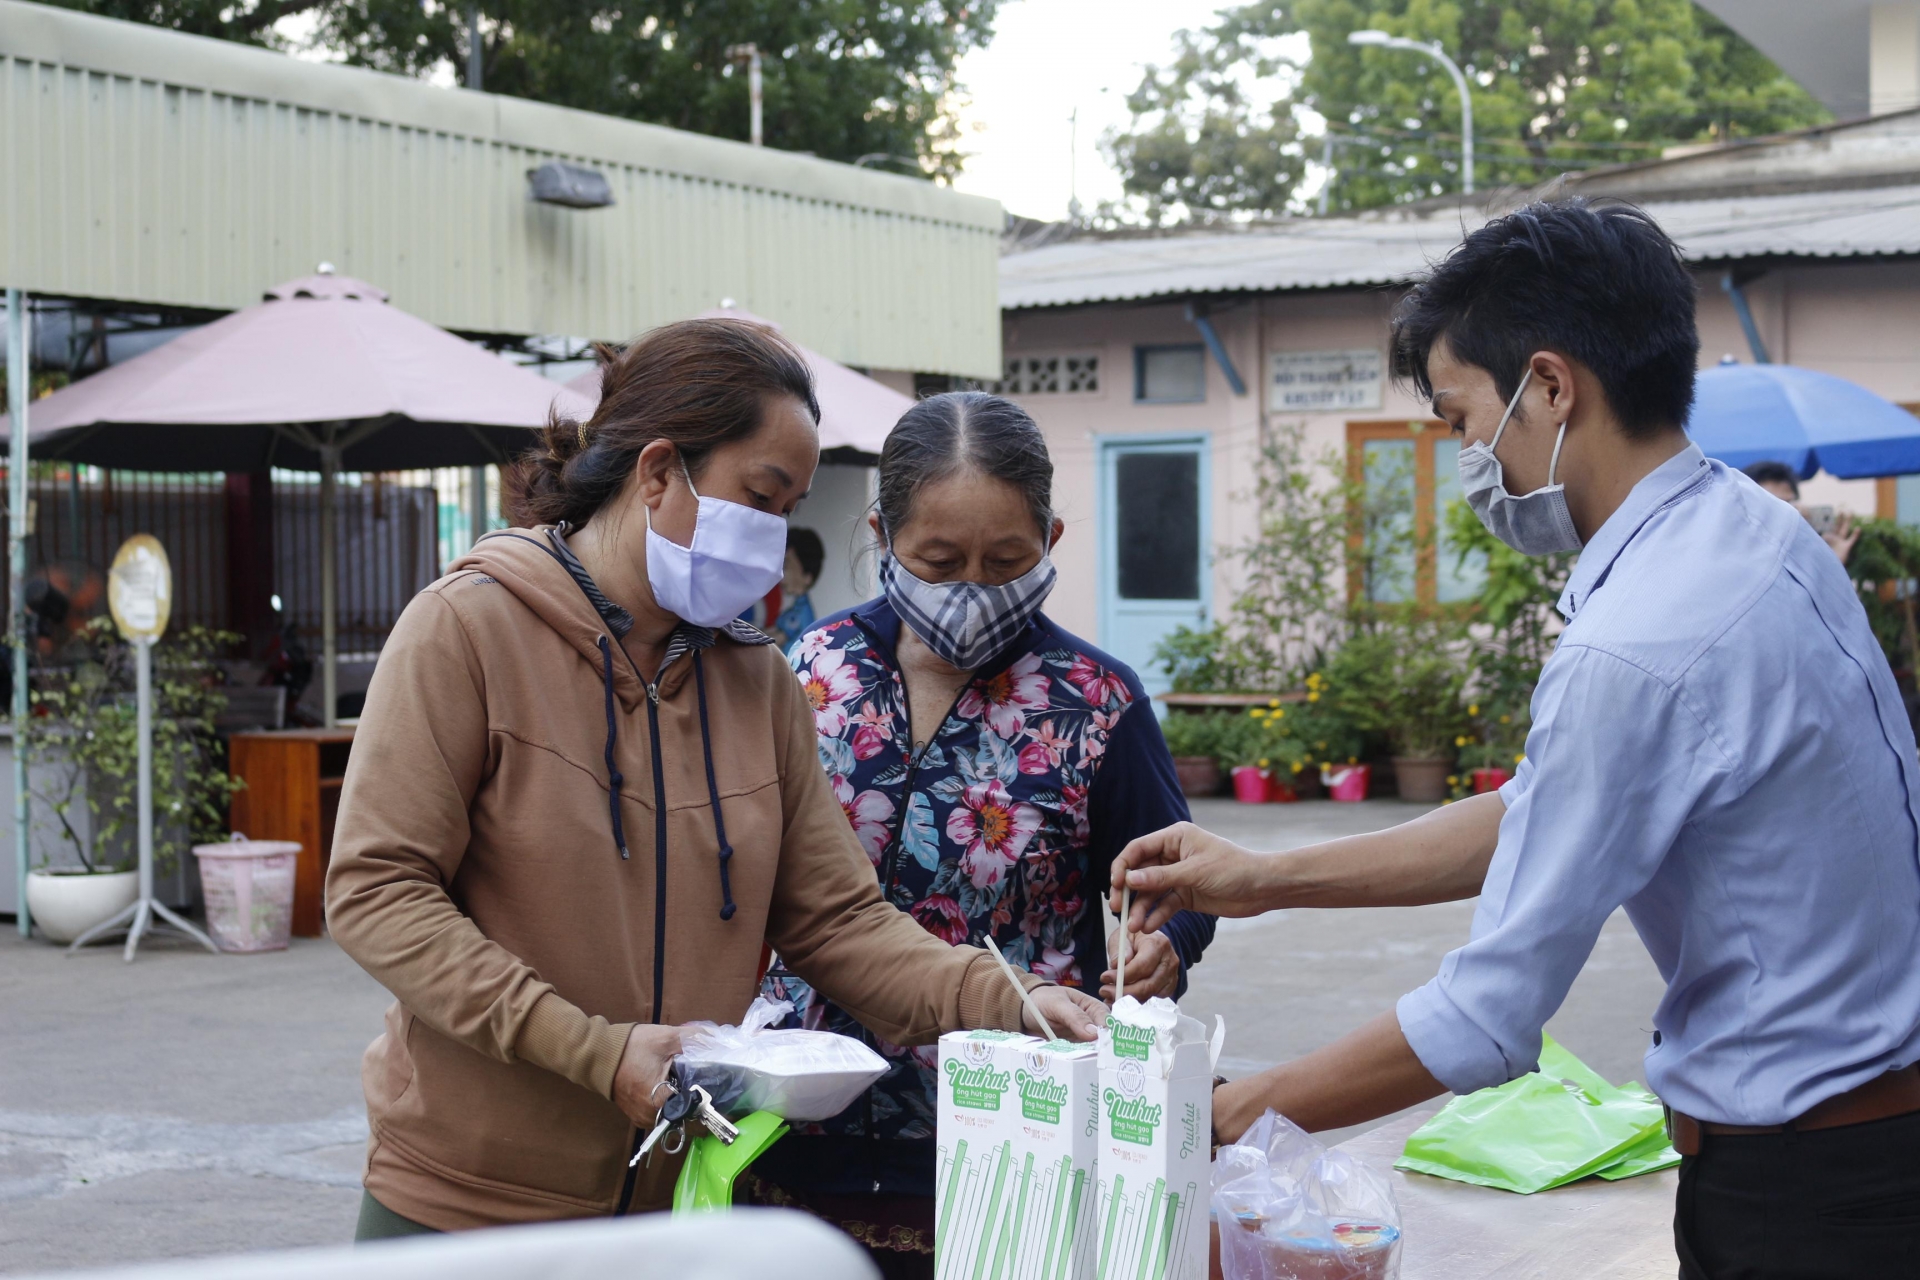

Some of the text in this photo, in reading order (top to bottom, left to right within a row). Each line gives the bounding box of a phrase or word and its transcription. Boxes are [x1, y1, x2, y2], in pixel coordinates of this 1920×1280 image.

[945, 1059, 1010, 1091] Nuihut
[1016, 1070, 1067, 1104] Nuihut
[957, 1087, 997, 1100] ống hút gạo
[1036, 1101, 1046, 1110] hút
[1085, 1082, 1099, 1137] Nuihut
[1104, 1089, 1161, 1125] Nuihut
[1114, 1119, 1150, 1134] ống hút gạo
[1179, 1102, 1195, 1160] Nuihut
